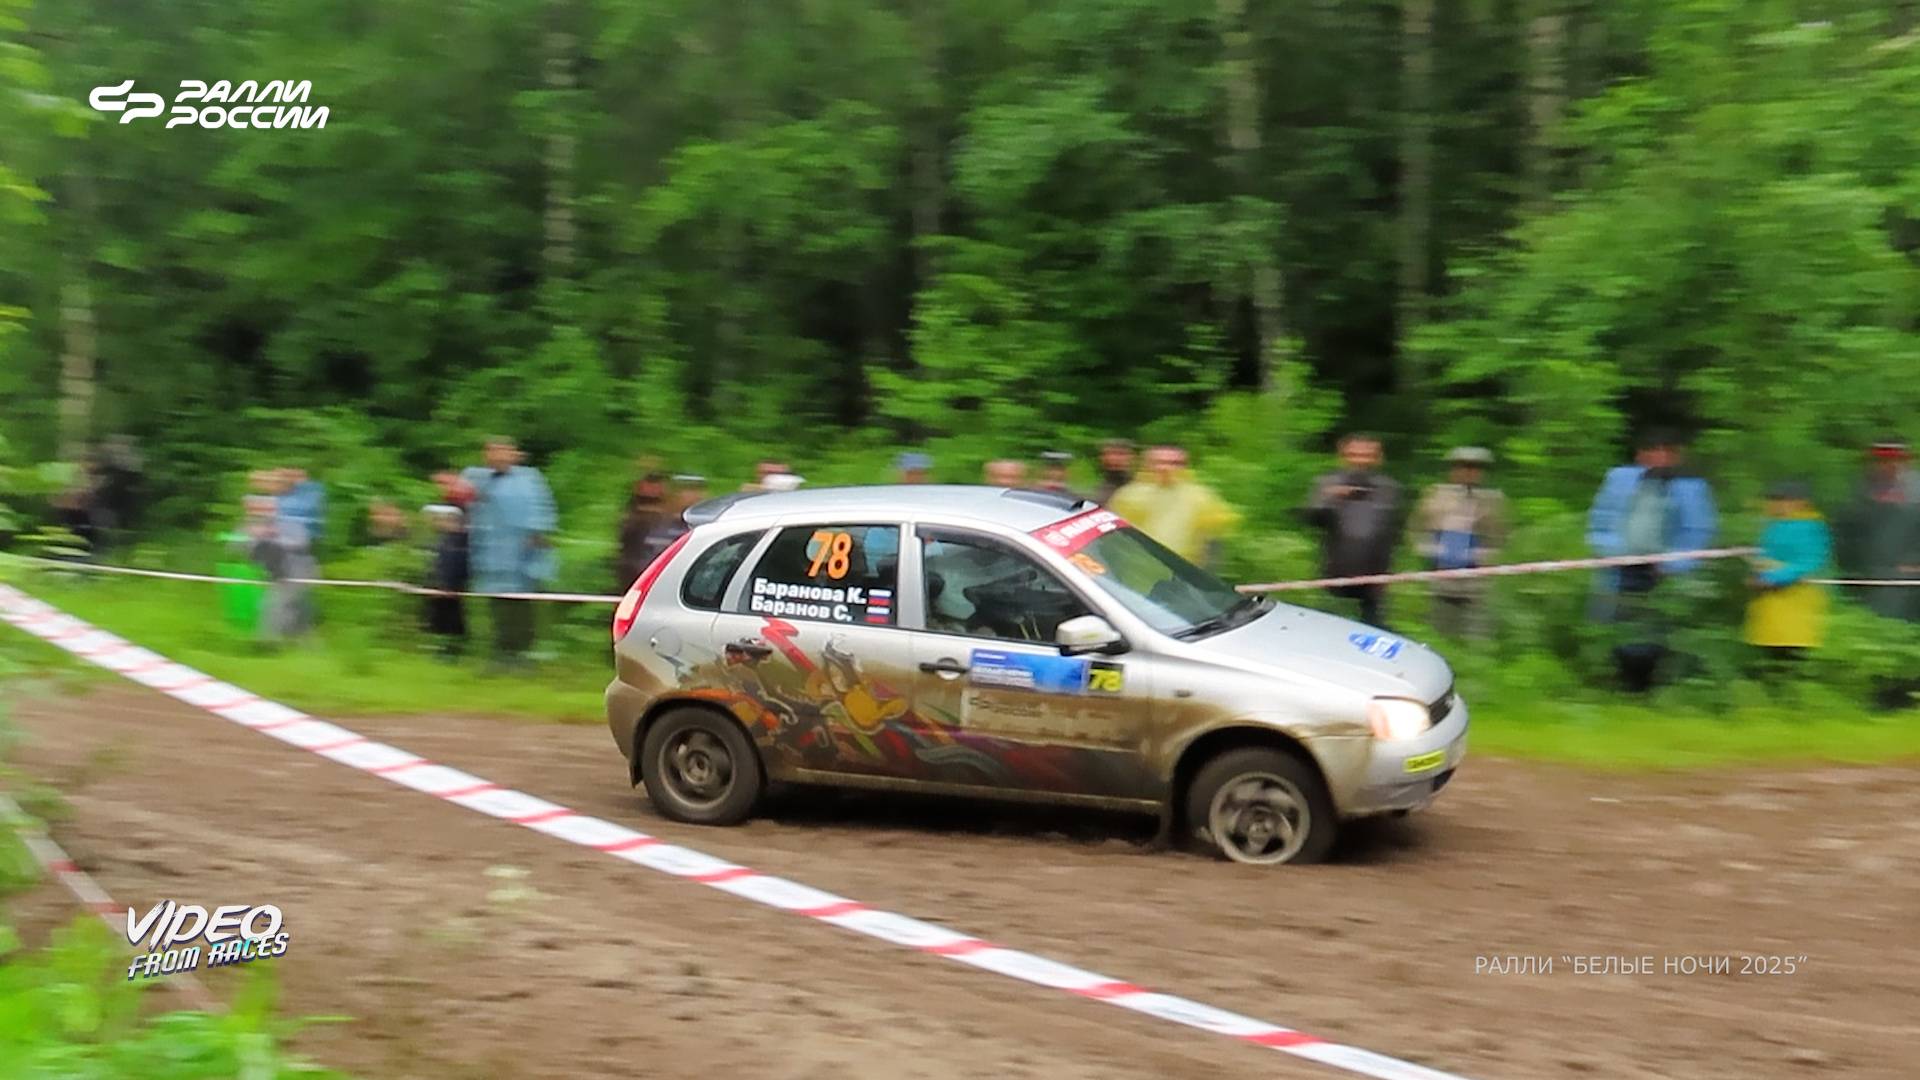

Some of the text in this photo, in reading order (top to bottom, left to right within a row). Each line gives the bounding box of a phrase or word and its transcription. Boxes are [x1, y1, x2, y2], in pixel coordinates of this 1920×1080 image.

[808, 530, 852, 579] 78
[754, 578, 867, 604] Баранова К.
[751, 595, 852, 622] Баранов С.
[1089, 669, 1122, 692] 78
